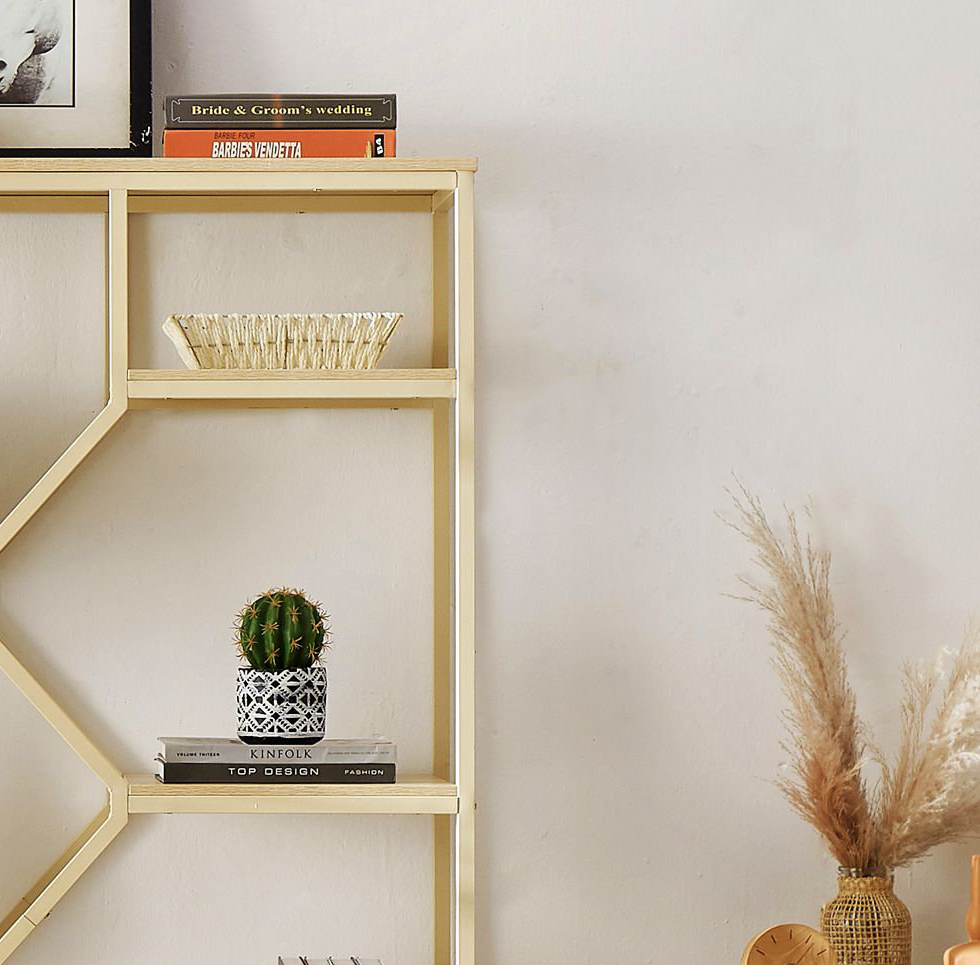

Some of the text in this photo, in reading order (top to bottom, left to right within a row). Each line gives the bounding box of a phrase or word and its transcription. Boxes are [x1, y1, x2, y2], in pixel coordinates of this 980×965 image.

[190, 104, 373, 117] Bride & Groom's wedding
[238, 131, 256, 139] FOUR
[254, 141, 302, 158] VENDETTA
[249, 748, 313, 759] KINFOLK
[227, 767, 320, 776] TOP DESIGN
